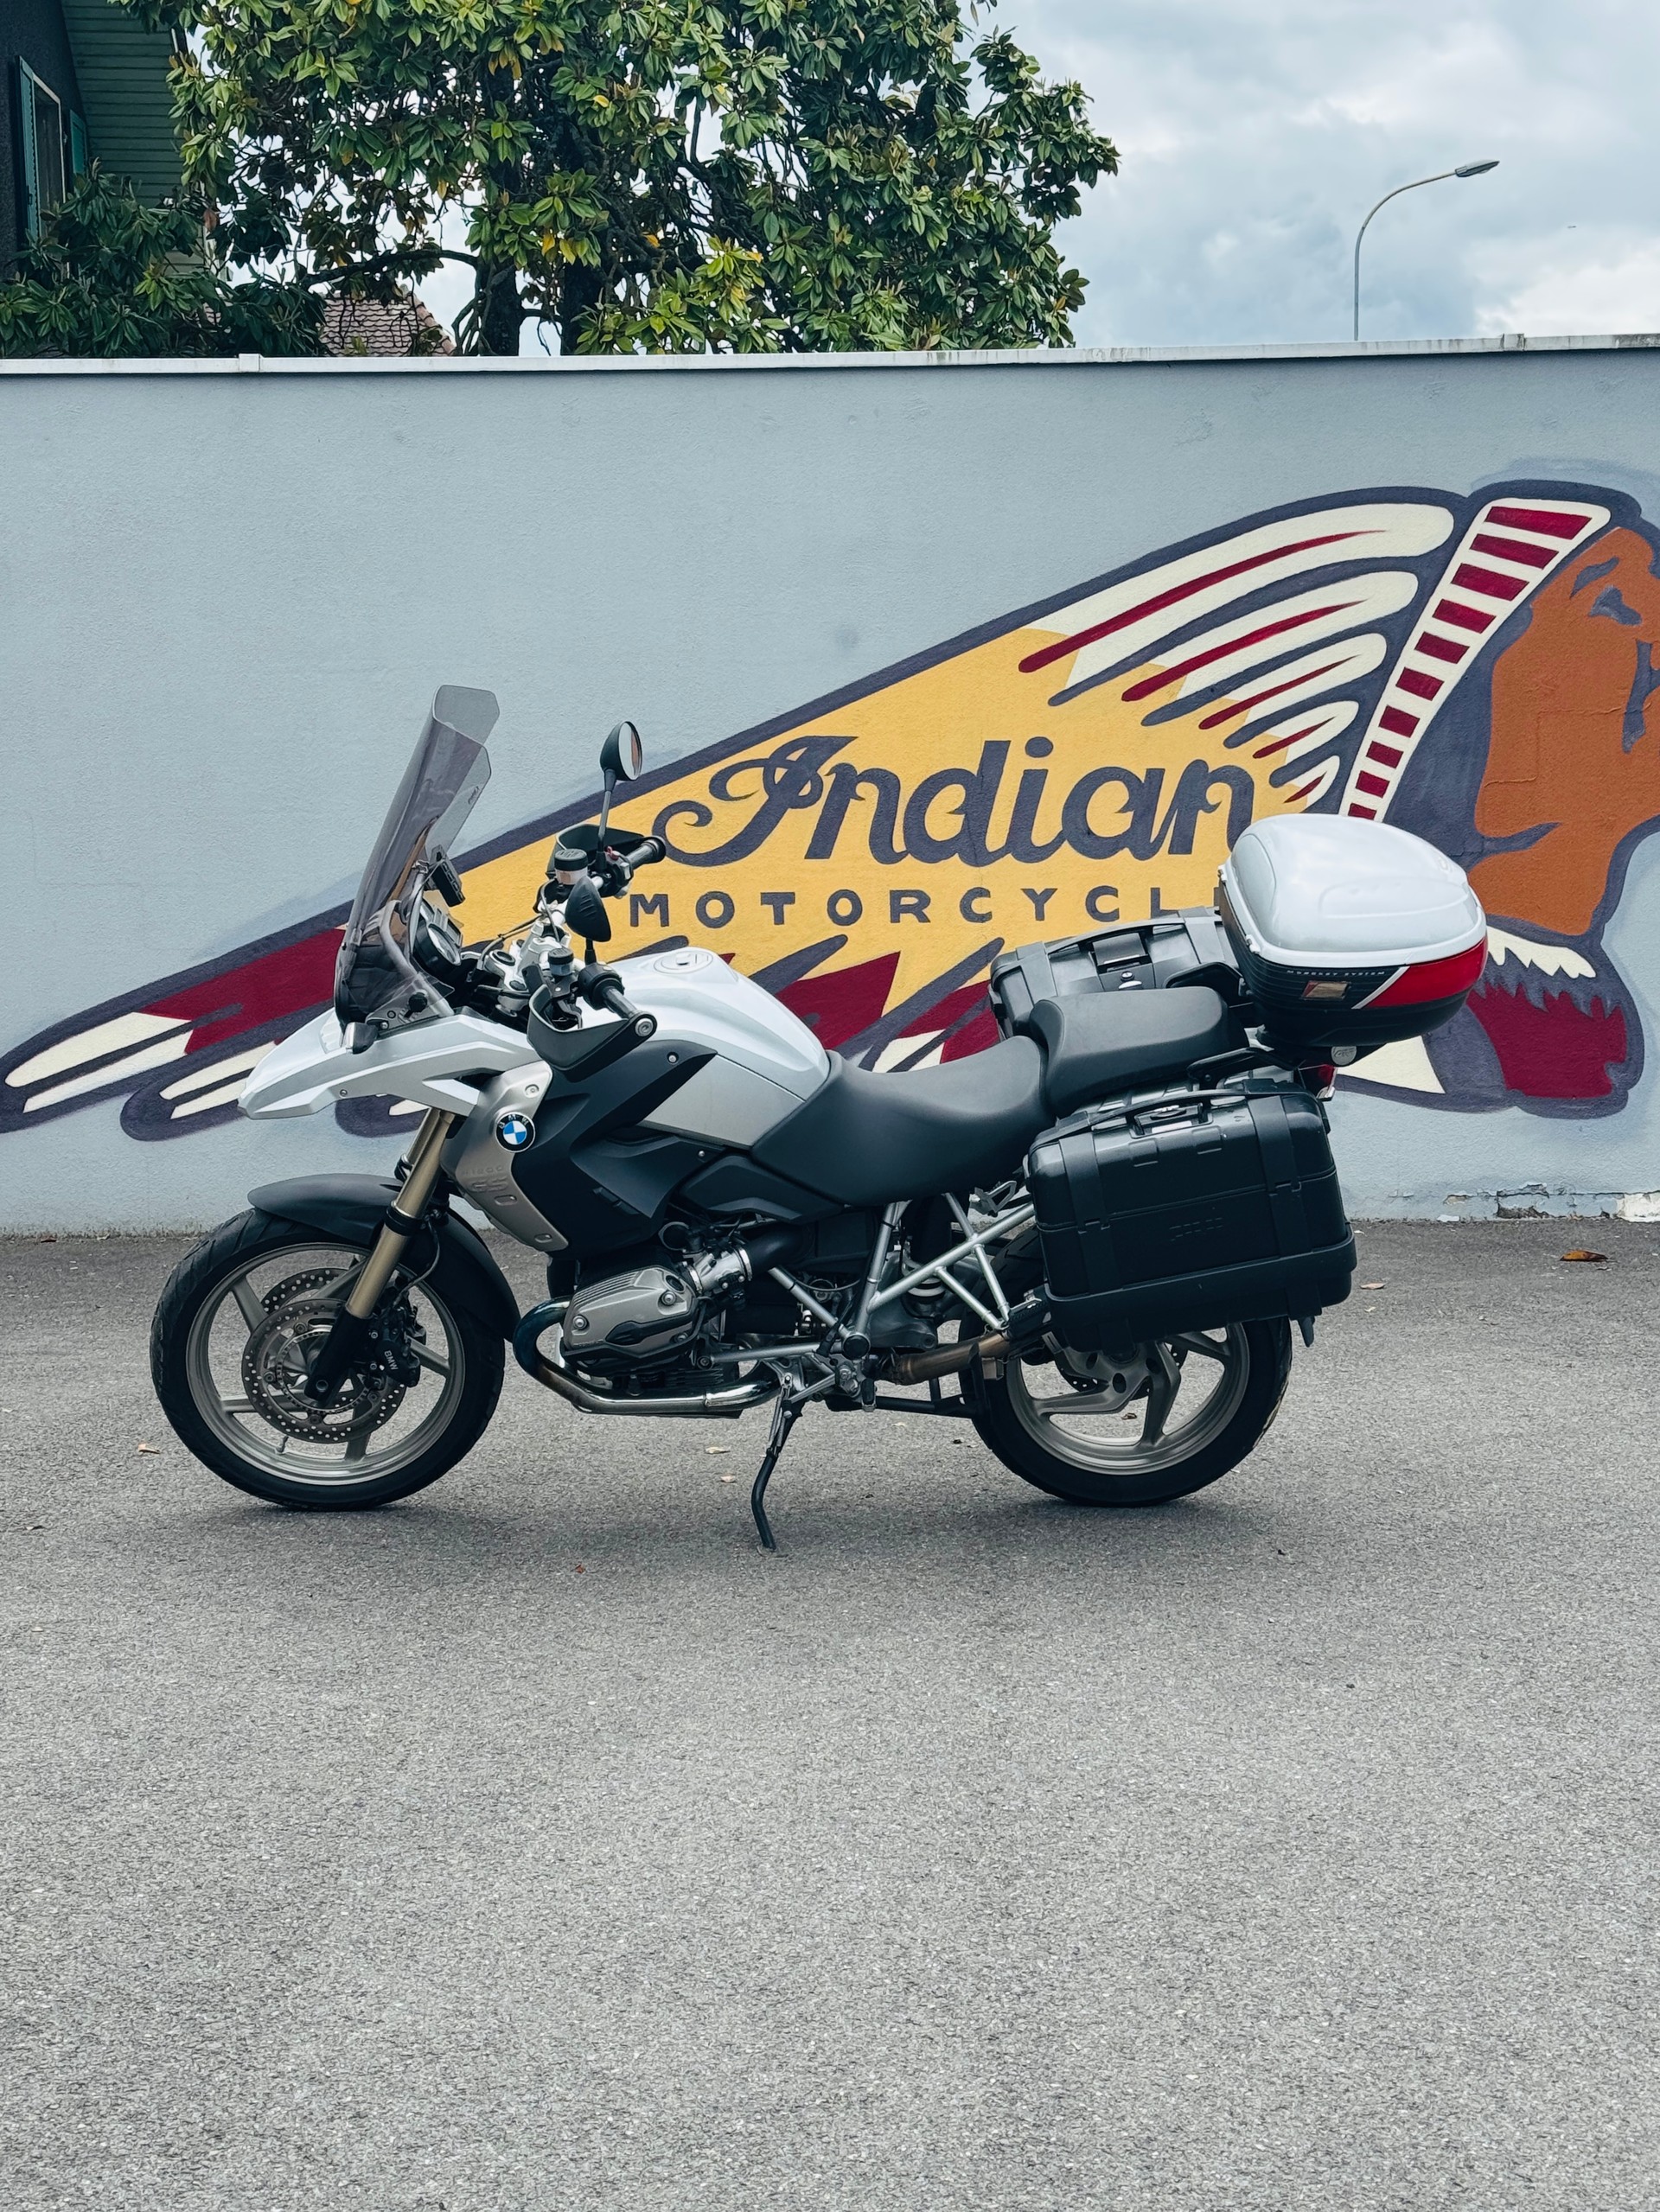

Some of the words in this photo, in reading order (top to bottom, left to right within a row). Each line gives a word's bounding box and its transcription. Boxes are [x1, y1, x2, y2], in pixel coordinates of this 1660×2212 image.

[652, 736, 1255, 867] Indian
[629, 885, 1220, 928] MOTORCYCL
[384, 1350, 399, 1370] BMW
